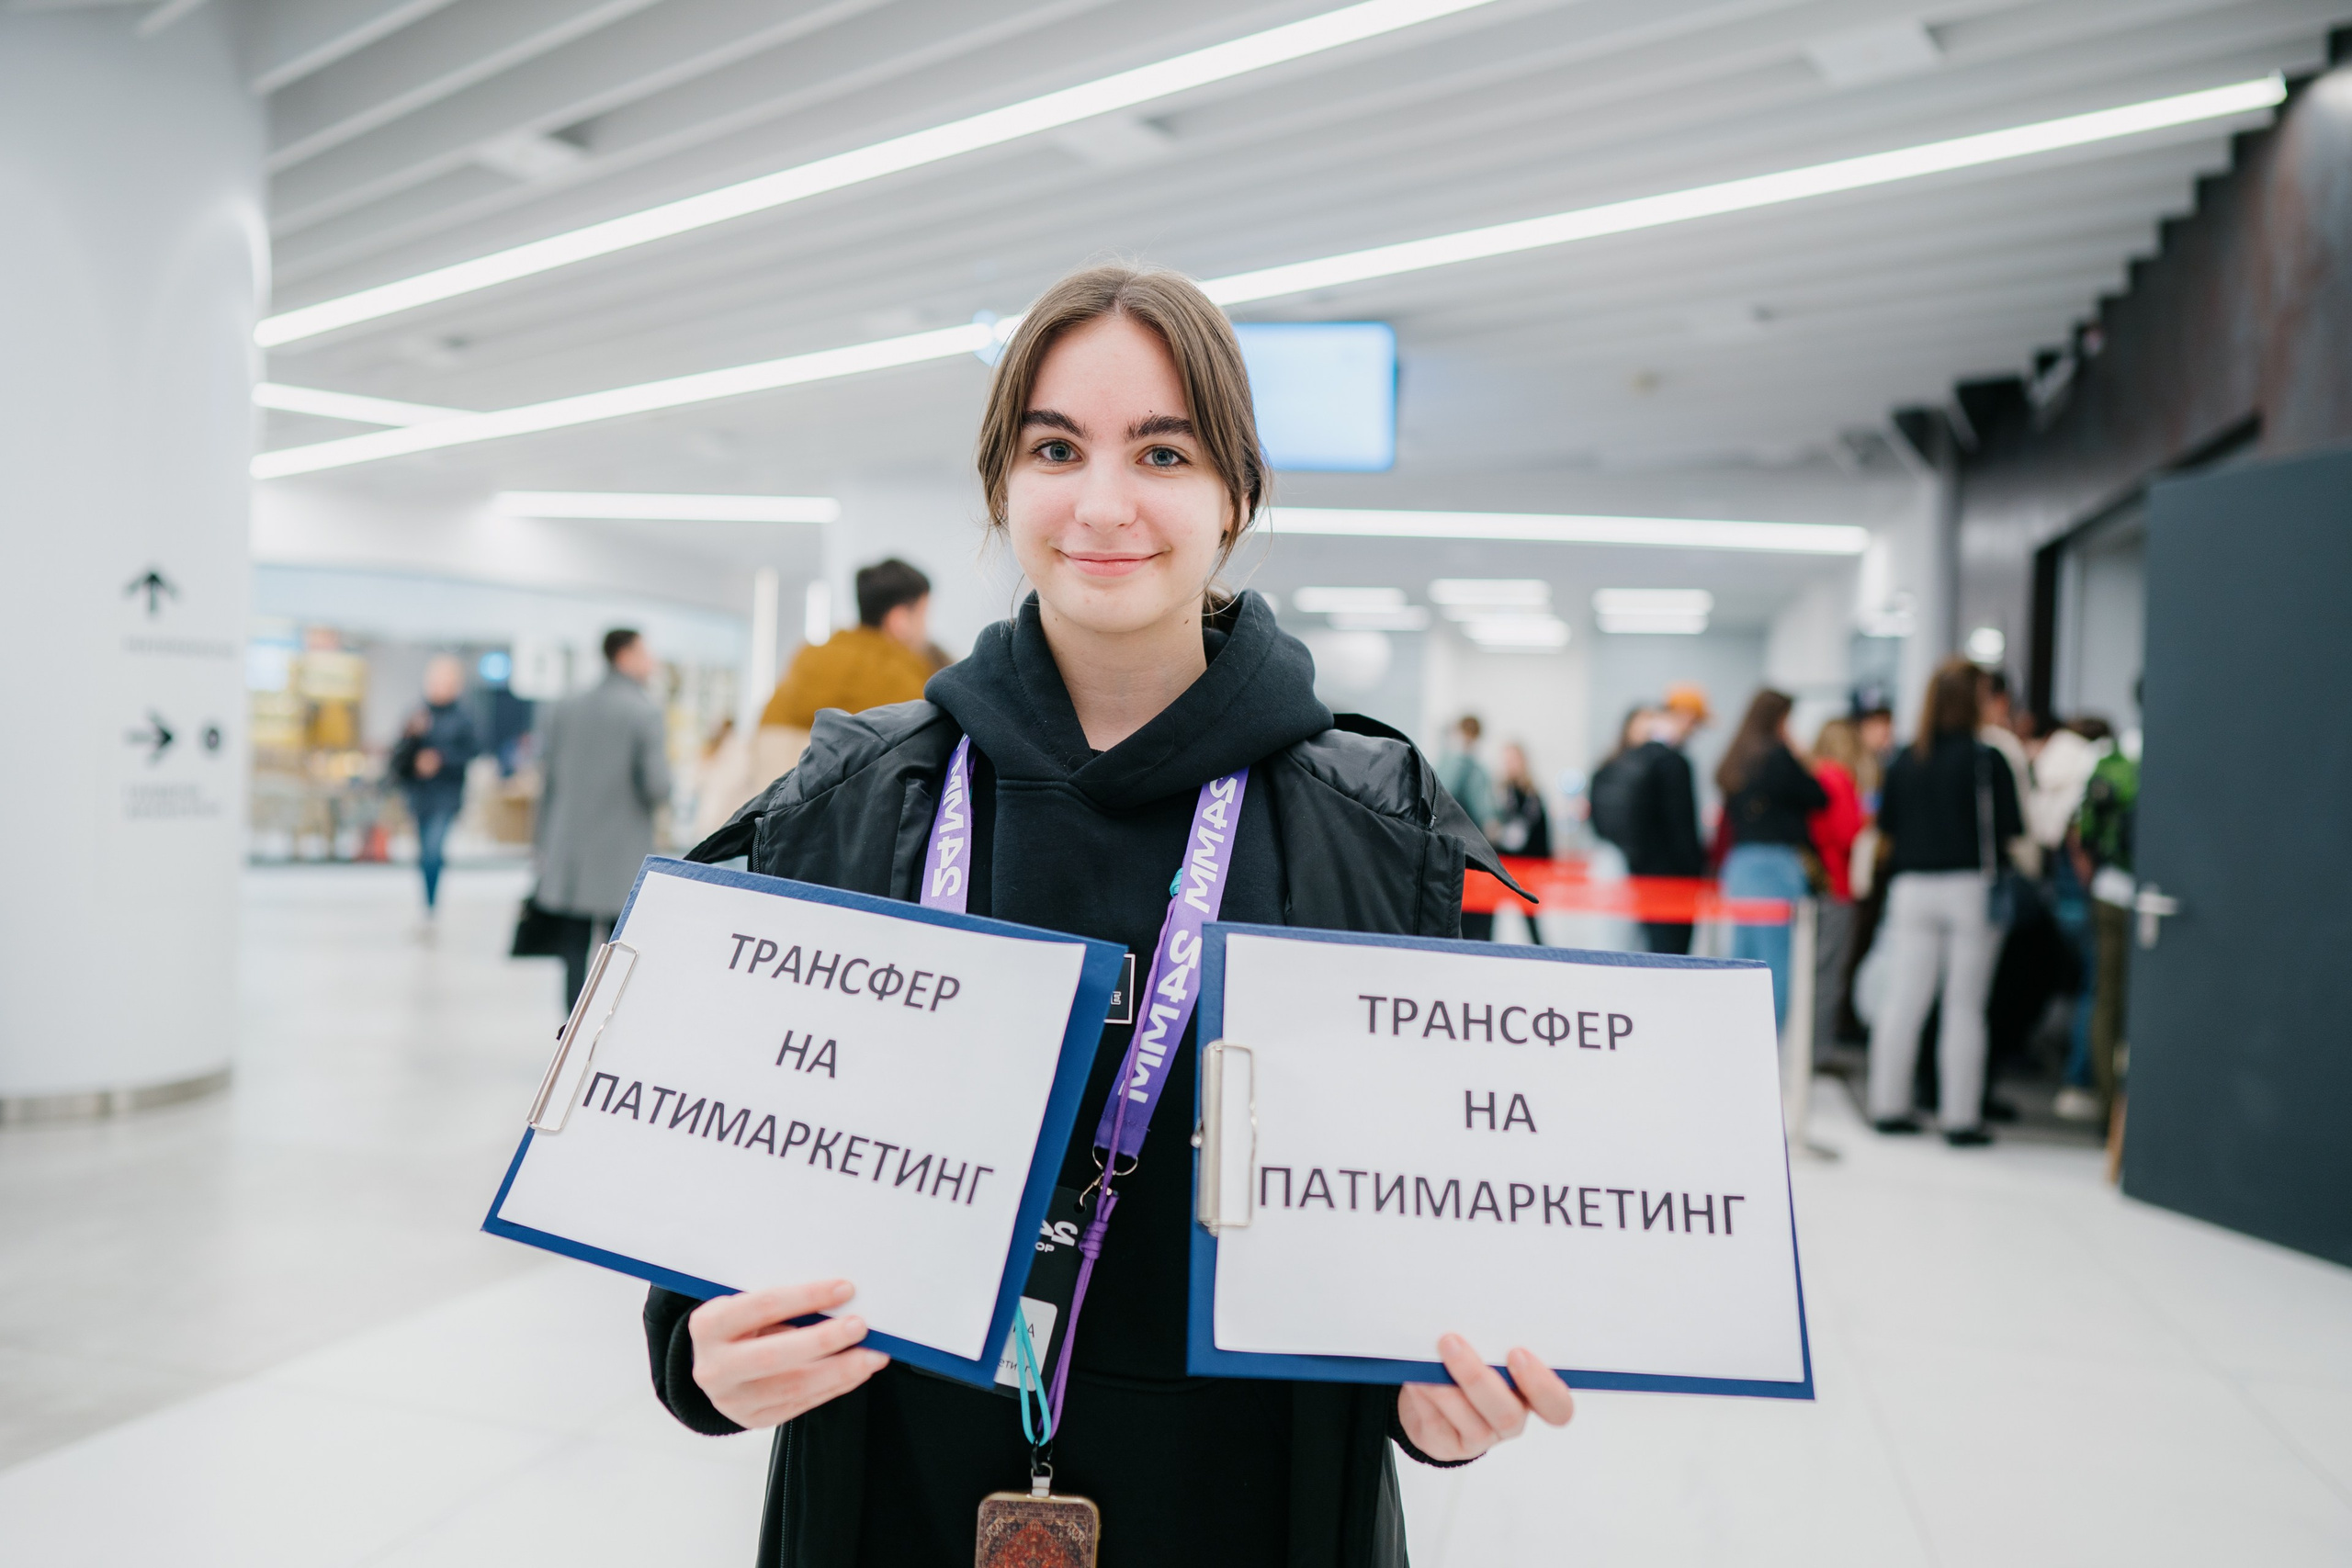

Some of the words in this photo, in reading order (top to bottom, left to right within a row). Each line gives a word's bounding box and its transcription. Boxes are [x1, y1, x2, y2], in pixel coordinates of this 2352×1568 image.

[729, 932, 961, 1012] ТРАНСФЕР
[1358, 995, 1634, 1050] ТРАНСФЕР
[775, 1030, 836, 1078] НА
[582, 1071, 995, 1205] ПАТИМАРКЕТИНГ
[1464, 1089, 1537, 1133] НА
[1260, 1166, 1746, 1235] ПАТИМАРКЕТИНГ
